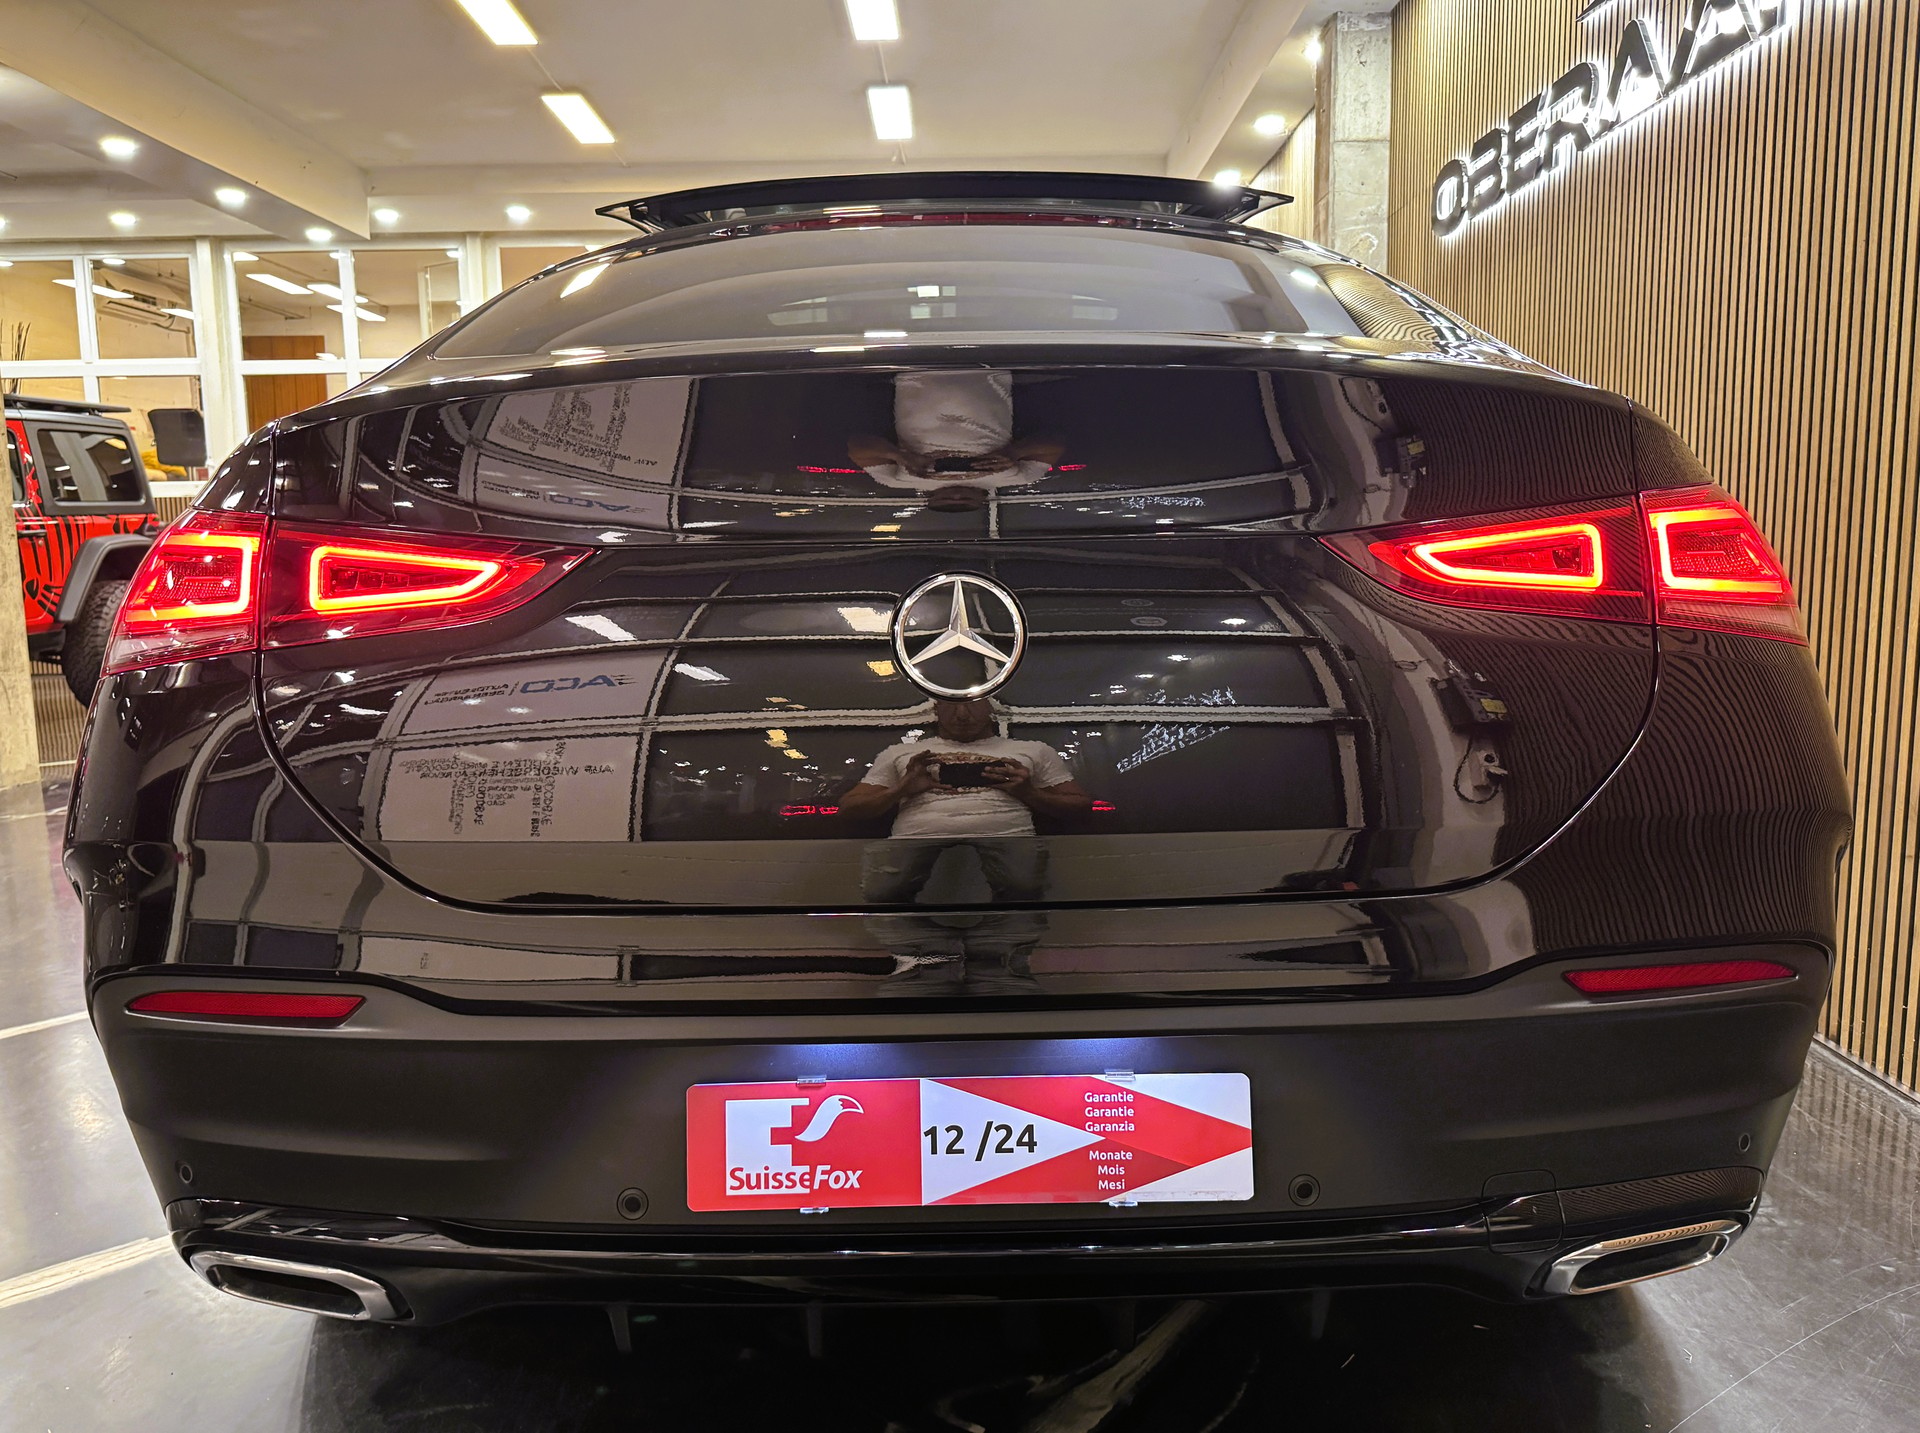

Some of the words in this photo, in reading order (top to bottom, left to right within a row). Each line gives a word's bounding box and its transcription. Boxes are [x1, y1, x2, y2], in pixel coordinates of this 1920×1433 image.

[1431, 0, 1790, 236] OBERAA
[1084, 1091, 1134, 1103] Garantie
[1084, 1106, 1135, 1118] Garantie
[1085, 1121, 1135, 1132] Garanzia
[923, 1125, 965, 1155] 12
[975, 1121, 1038, 1162] /24
[1089, 1150, 1133, 1161] Monate
[1097, 1164, 1125, 1175] Mois
[729, 1165, 863, 1191] SuisseFox
[1098, 1178, 1125, 1190] Mesi
